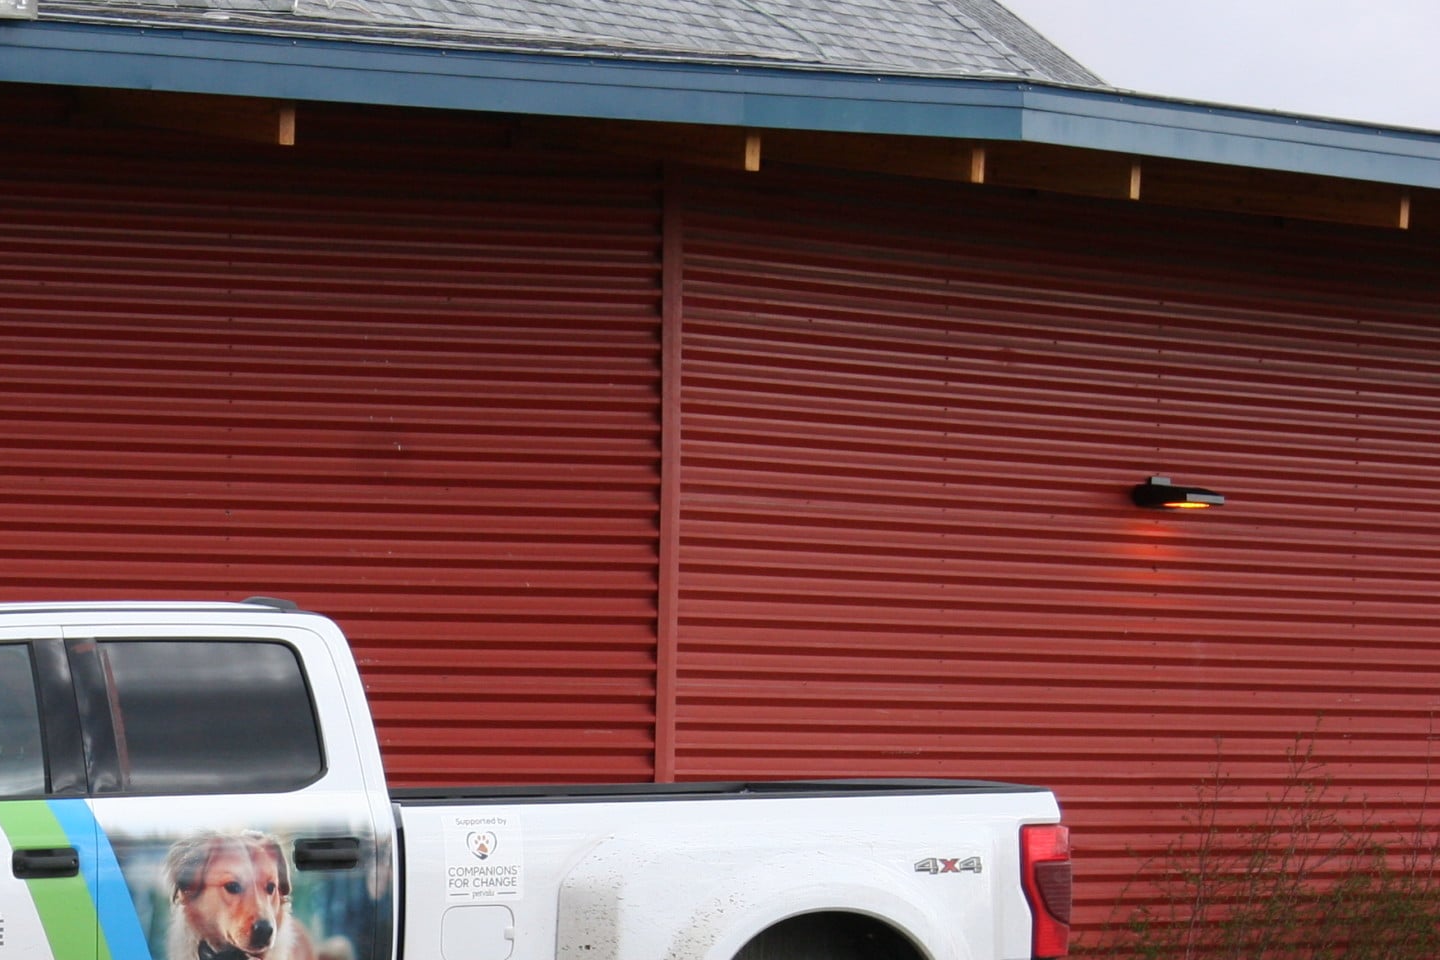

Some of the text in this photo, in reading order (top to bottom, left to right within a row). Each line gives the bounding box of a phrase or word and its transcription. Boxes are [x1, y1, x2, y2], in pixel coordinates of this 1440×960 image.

[497, 817, 507, 826] by
[448, 865, 518, 877] COMPANIONS
[448, 876, 517, 888] FOR CHANGE
